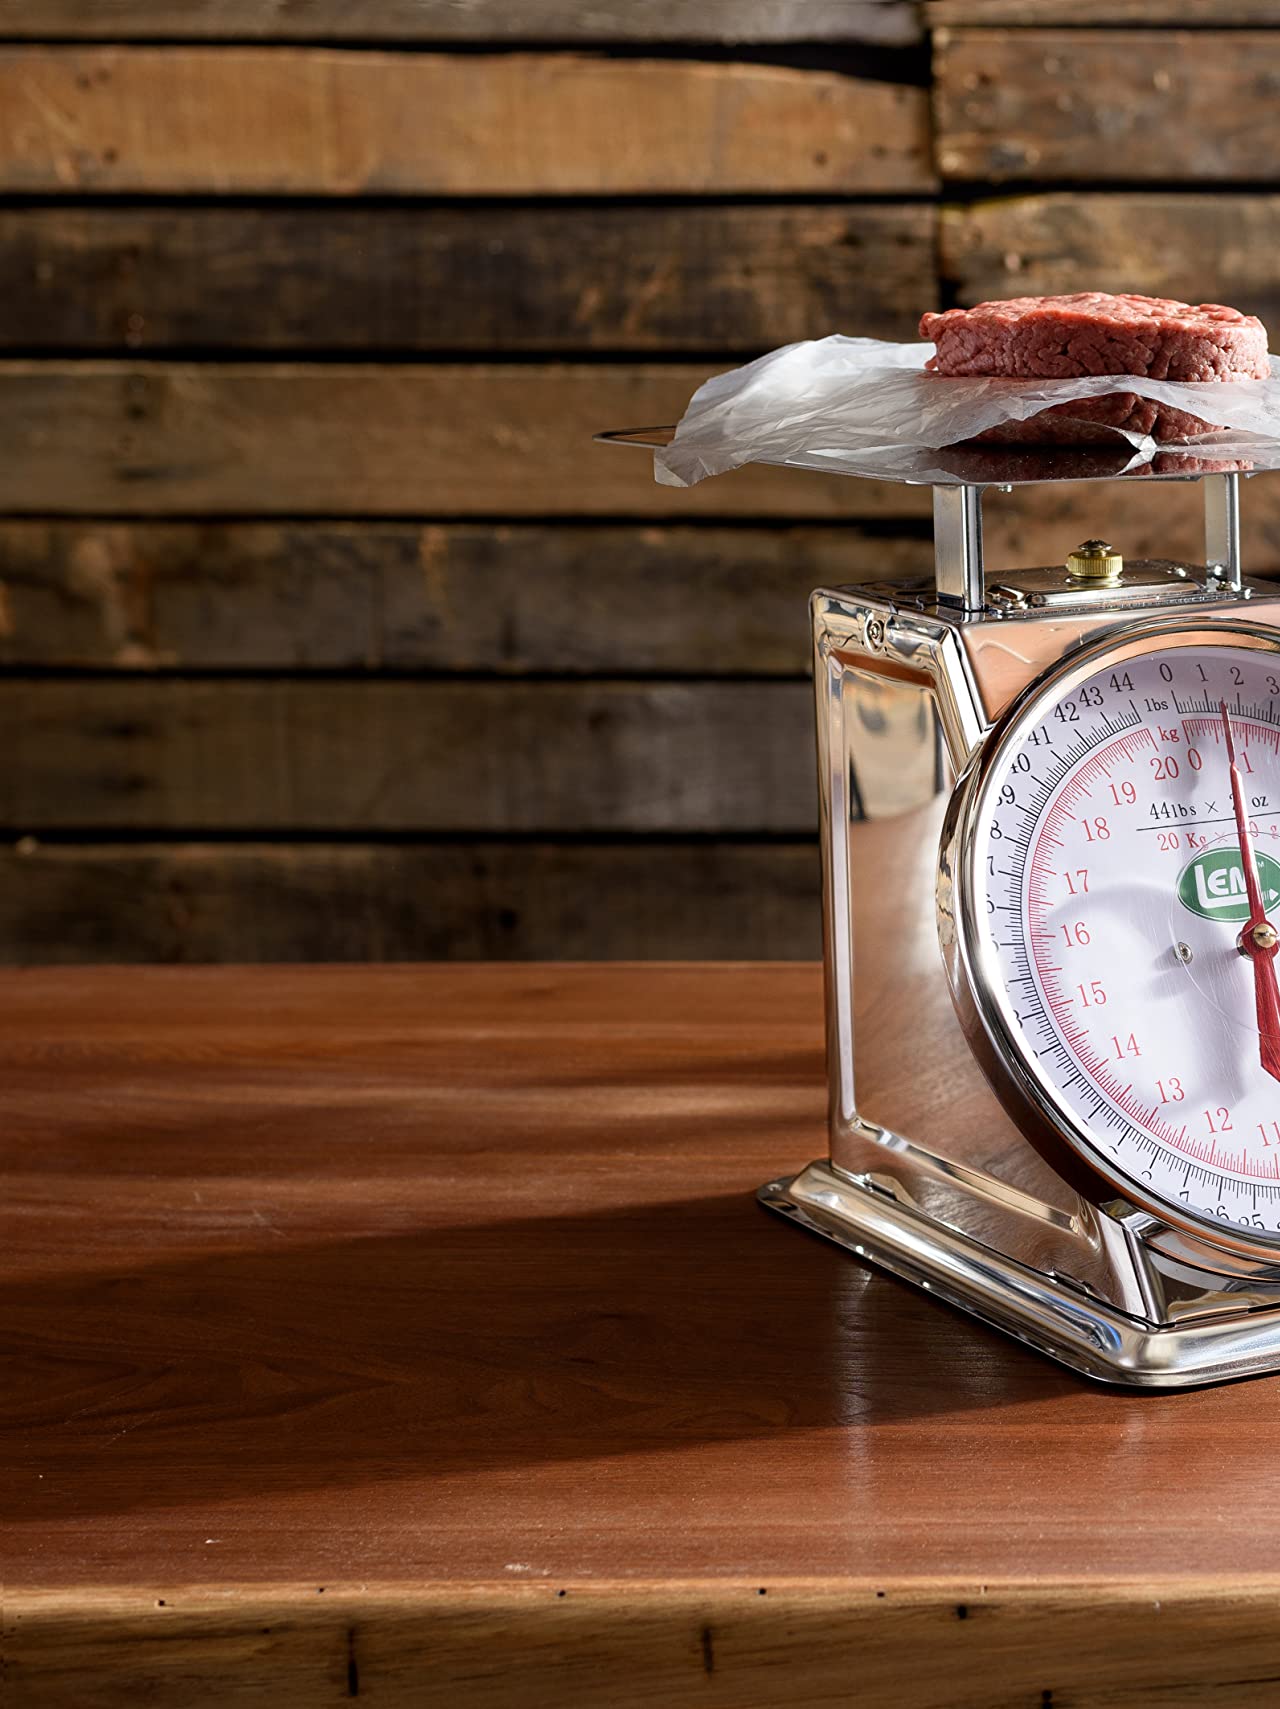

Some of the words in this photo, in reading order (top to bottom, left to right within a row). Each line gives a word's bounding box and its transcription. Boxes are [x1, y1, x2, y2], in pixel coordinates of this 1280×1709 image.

[1109, 672, 1135, 693] 44
[1159, 663, 1173, 682] 0
[1196, 664, 1208, 682] 1
[1230, 666, 1244, 685] 2
[1079, 686, 1104, 707] 43
[1266, 676, 1280, 695] 3
[1054, 701, 1080, 722] 42
[1144, 698, 1169, 712] lbs
[1027, 725, 1053, 746] 41
[1157, 726, 1180, 743] kg
[1150, 756, 1179, 781] 20
[1187, 748, 1203, 771] 0
[1240, 751, 1254, 774] 1
[1108, 781, 1137, 806] 19
[1150, 801, 1197, 820] 44lbs
[1252, 796, 1269, 808] oz
[1081, 817, 1110, 842] 18
[1157, 832, 1179, 851] 20
[1185, 833, 1208, 851] Kg
[1270, 825, 1278, 839] g
[1063, 869, 1089, 895] 17
[1060, 922, 1090, 948] 16
[1076, 980, 1107, 1008] 15
[1110, 1033, 1142, 1060] 14
[1155, 1077, 1185, 1104] 13
[1203, 1107, 1233, 1134] 12
